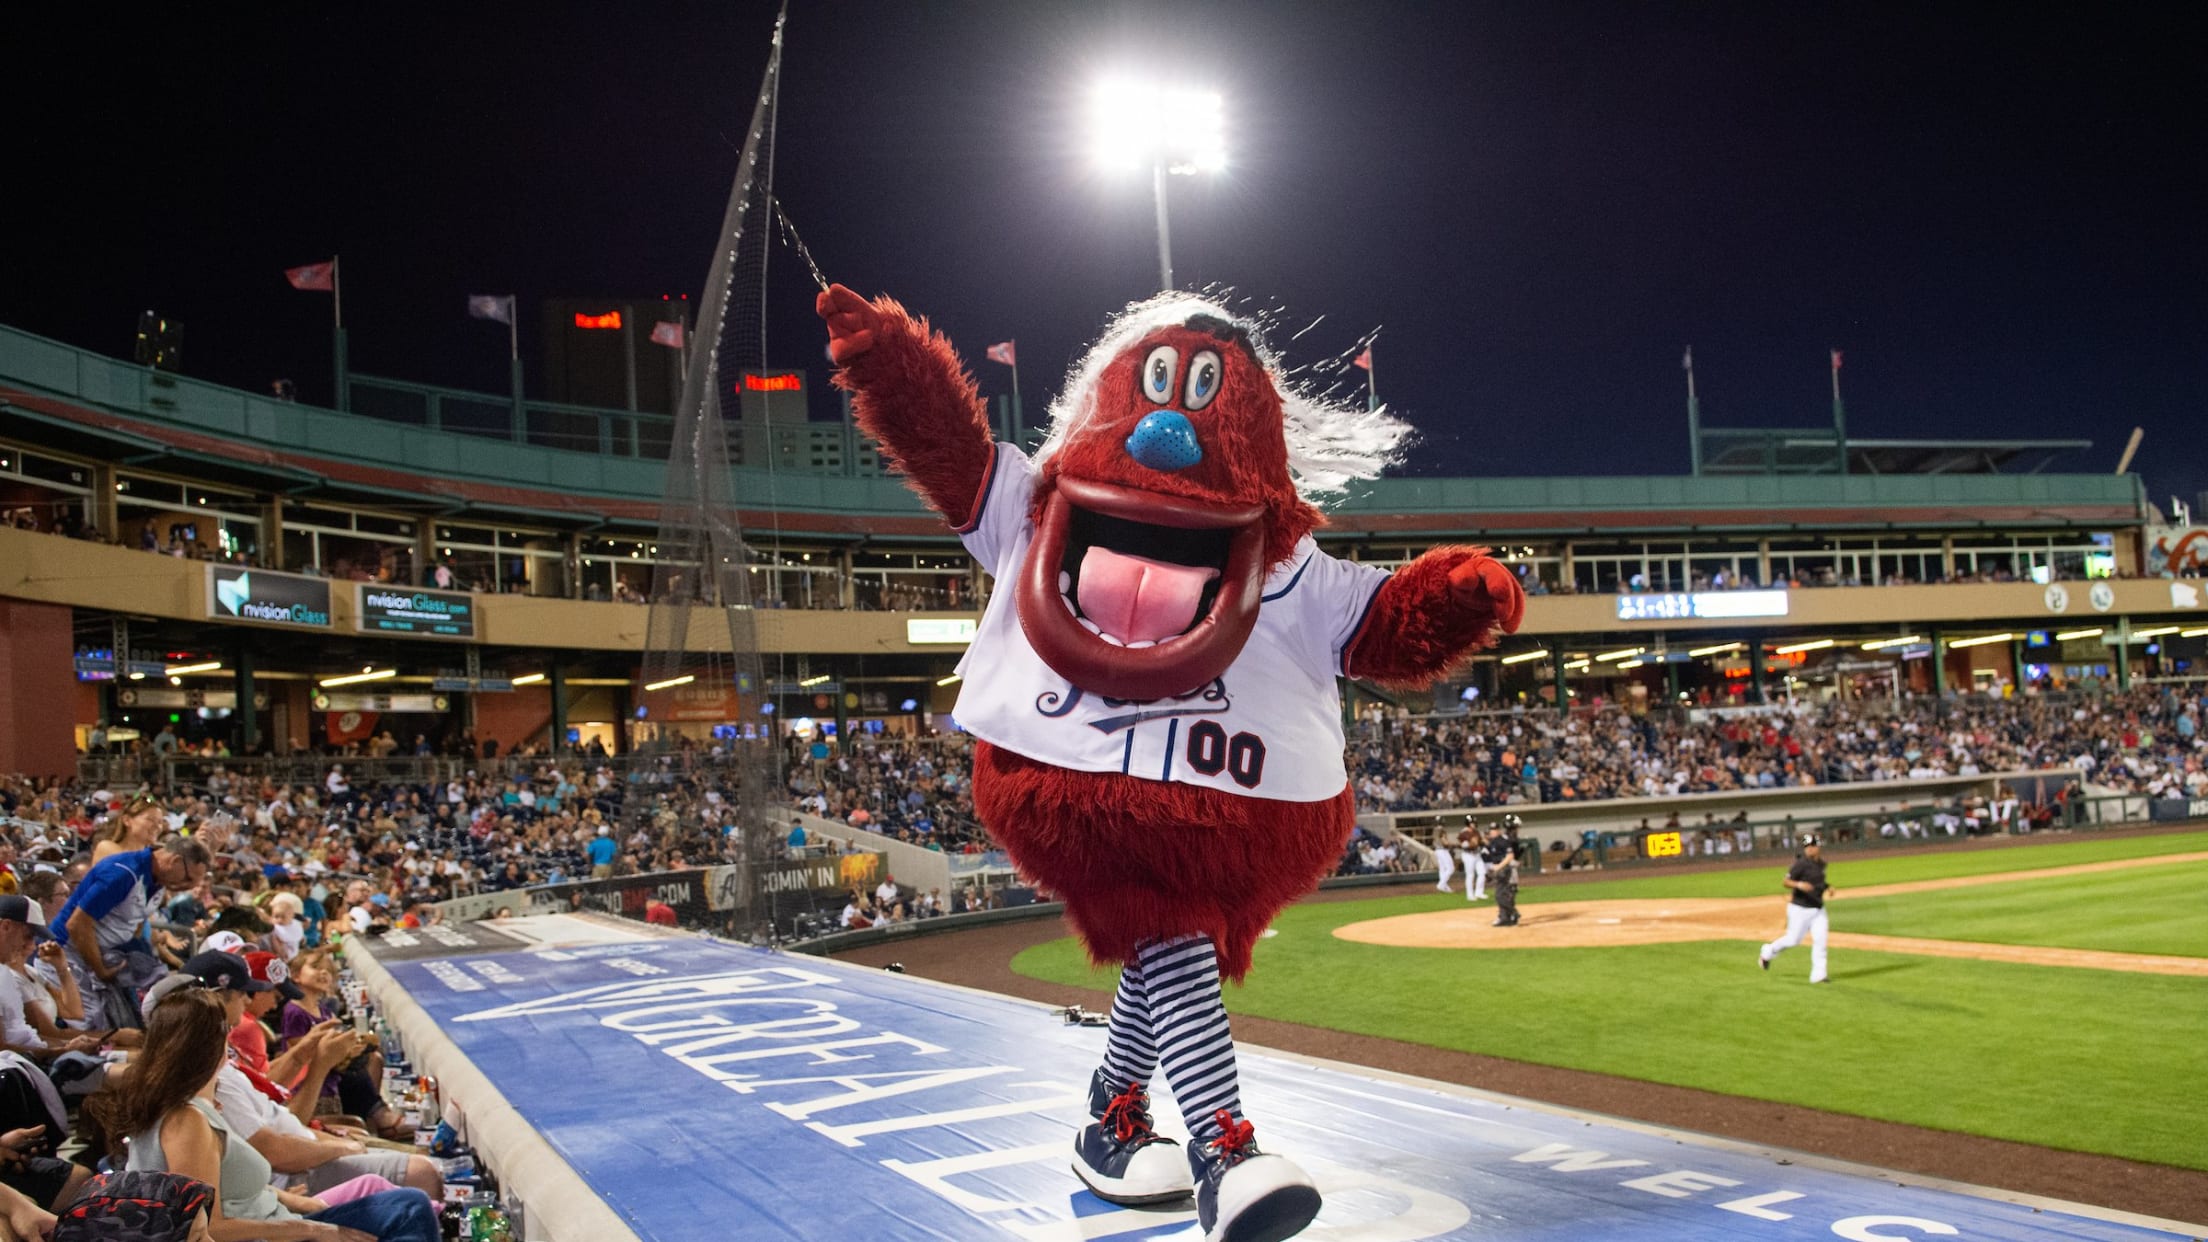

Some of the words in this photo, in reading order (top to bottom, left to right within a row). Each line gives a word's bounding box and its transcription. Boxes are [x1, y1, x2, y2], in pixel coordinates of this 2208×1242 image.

[1187, 719, 1266, 789] 00
[1647, 831, 1681, 857] 053
[763, 868, 812, 893] OMIN'
[817, 866, 835, 888] IN
